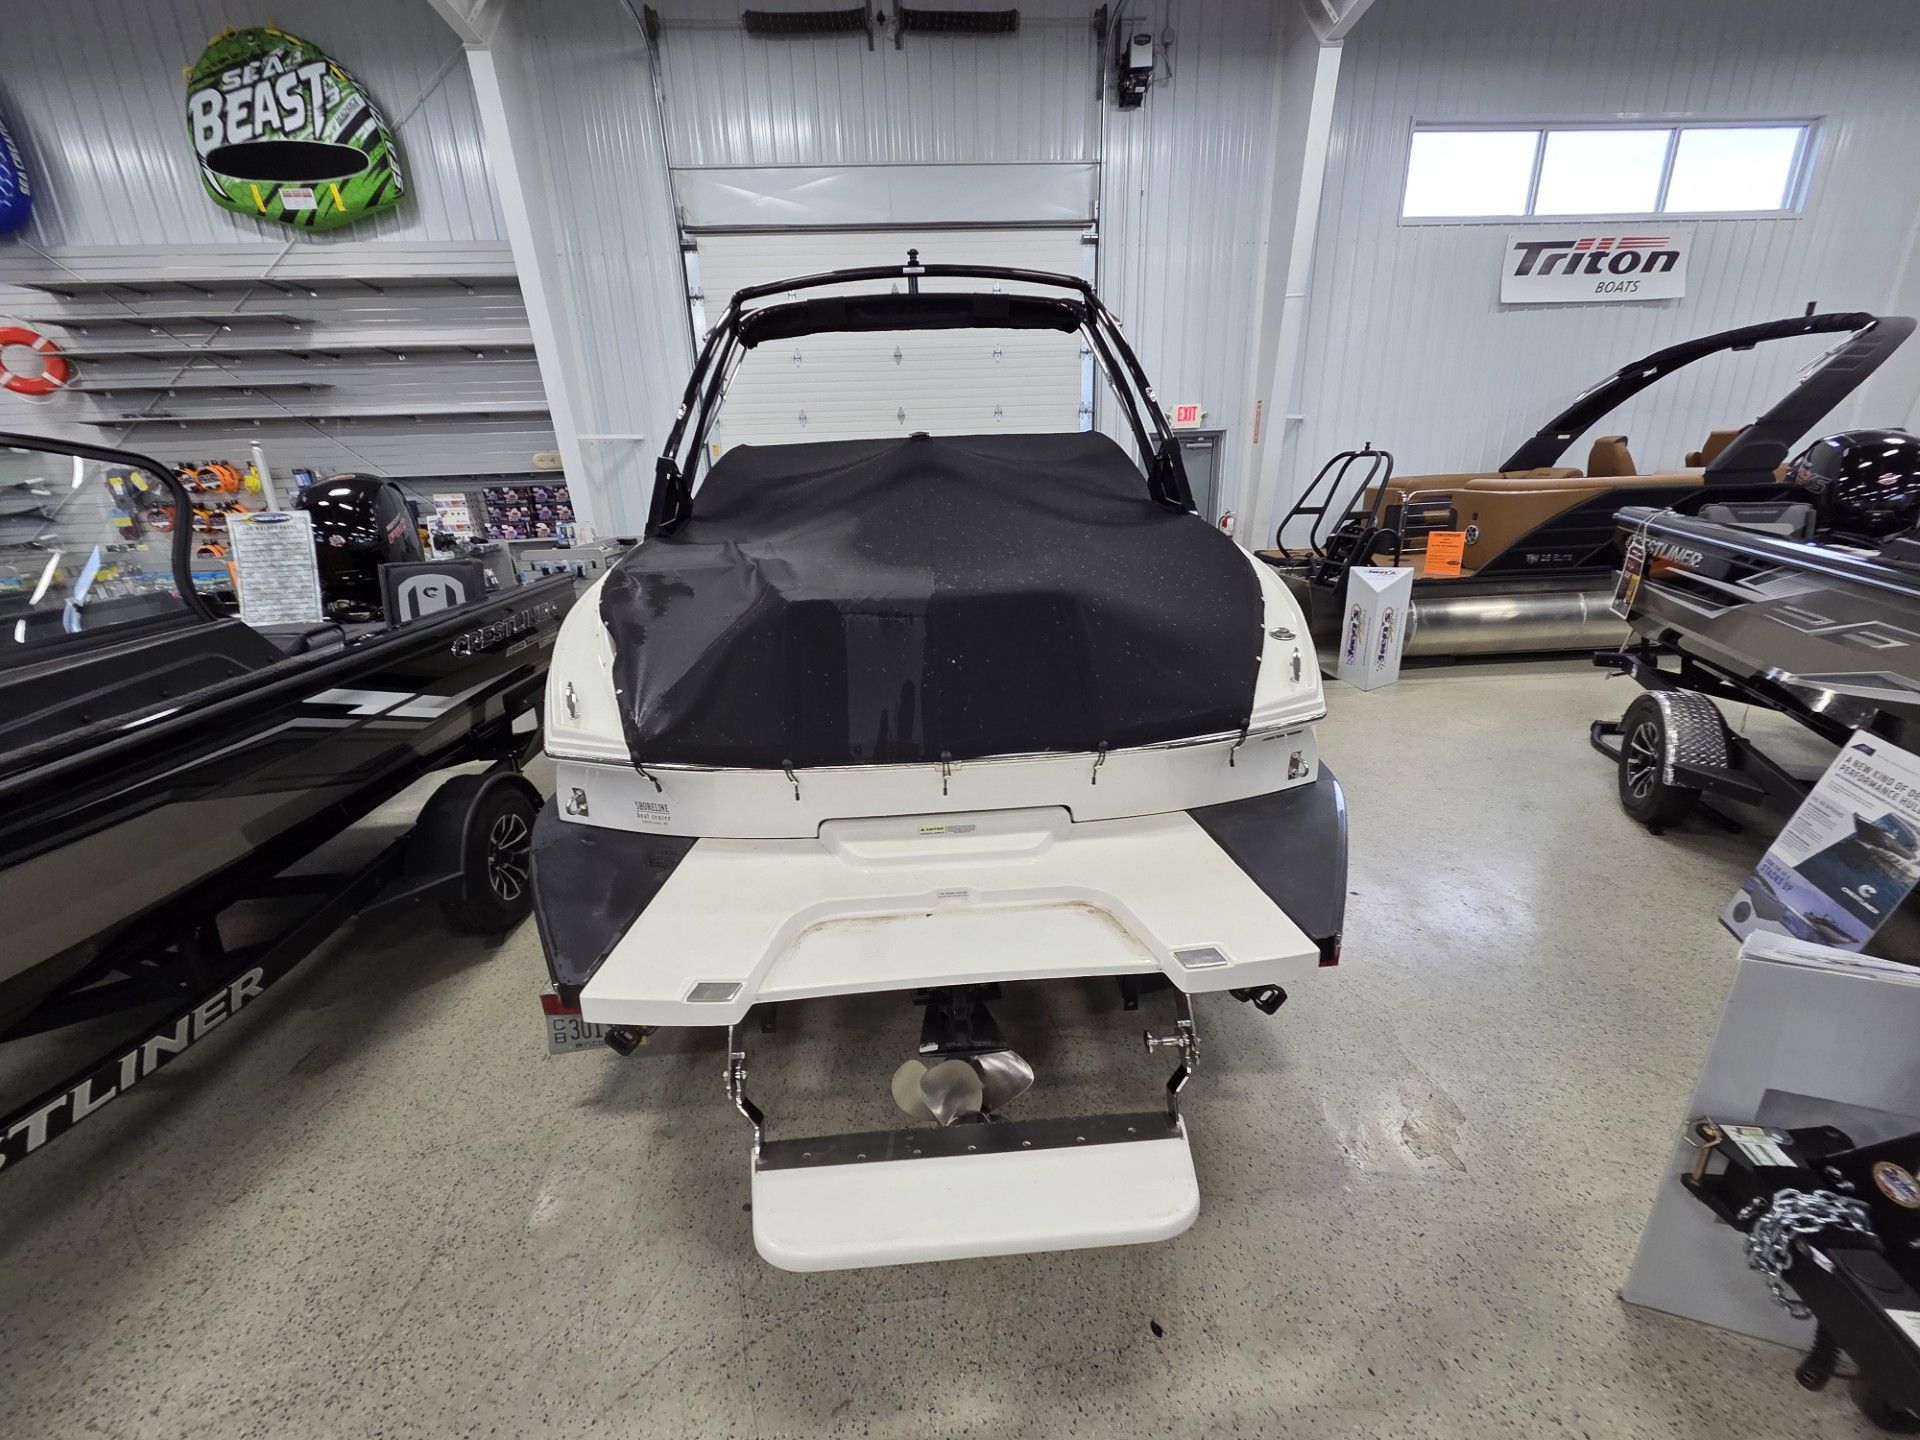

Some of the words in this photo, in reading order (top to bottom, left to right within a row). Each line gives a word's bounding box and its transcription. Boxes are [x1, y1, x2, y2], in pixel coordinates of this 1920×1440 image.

[222, 53, 286, 91] SEA
[188, 62, 326, 155] BEAST
[1514, 237, 1680, 276] Triton
[1595, 280, 1640, 294] BOATS
[1177, 405, 1198, 422] EXIT
[1839, 763, 1900, 801] PERFORMANCE
[634, 801, 670, 813] SHORELINE
[0, 967, 265, 1168] TLINER
